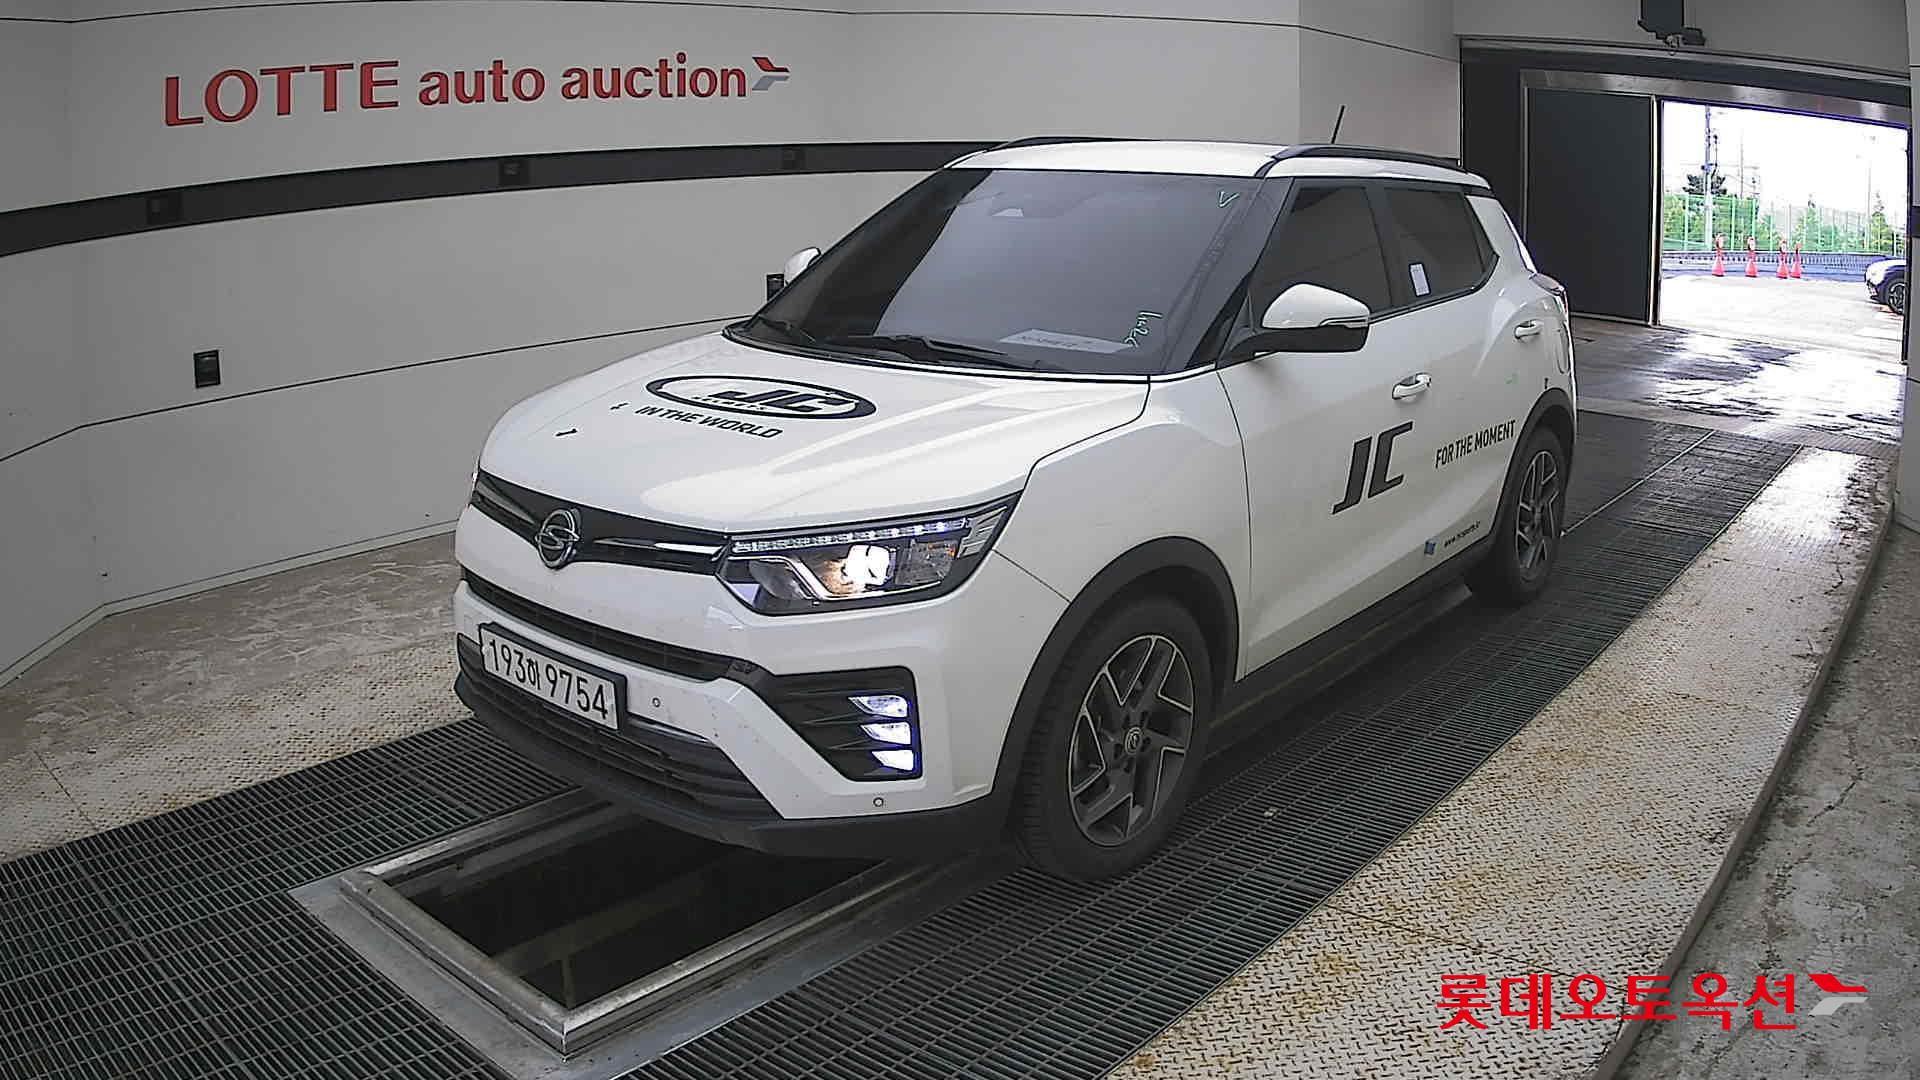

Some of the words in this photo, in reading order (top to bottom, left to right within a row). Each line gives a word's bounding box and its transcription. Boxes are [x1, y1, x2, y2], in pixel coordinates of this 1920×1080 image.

[164, 59, 400, 127] LOTTE
[418, 59, 546, 105] auto
[561, 52, 747, 100] auction
[635, 405, 659, 416] IN
[659, 408, 704, 424] THE
[698, 415, 784, 439] WORLD
[1435, 443, 1455, 469] FOR
[1455, 434, 1474, 459] THE
[1474, 419, 1516, 452] MOMENT
